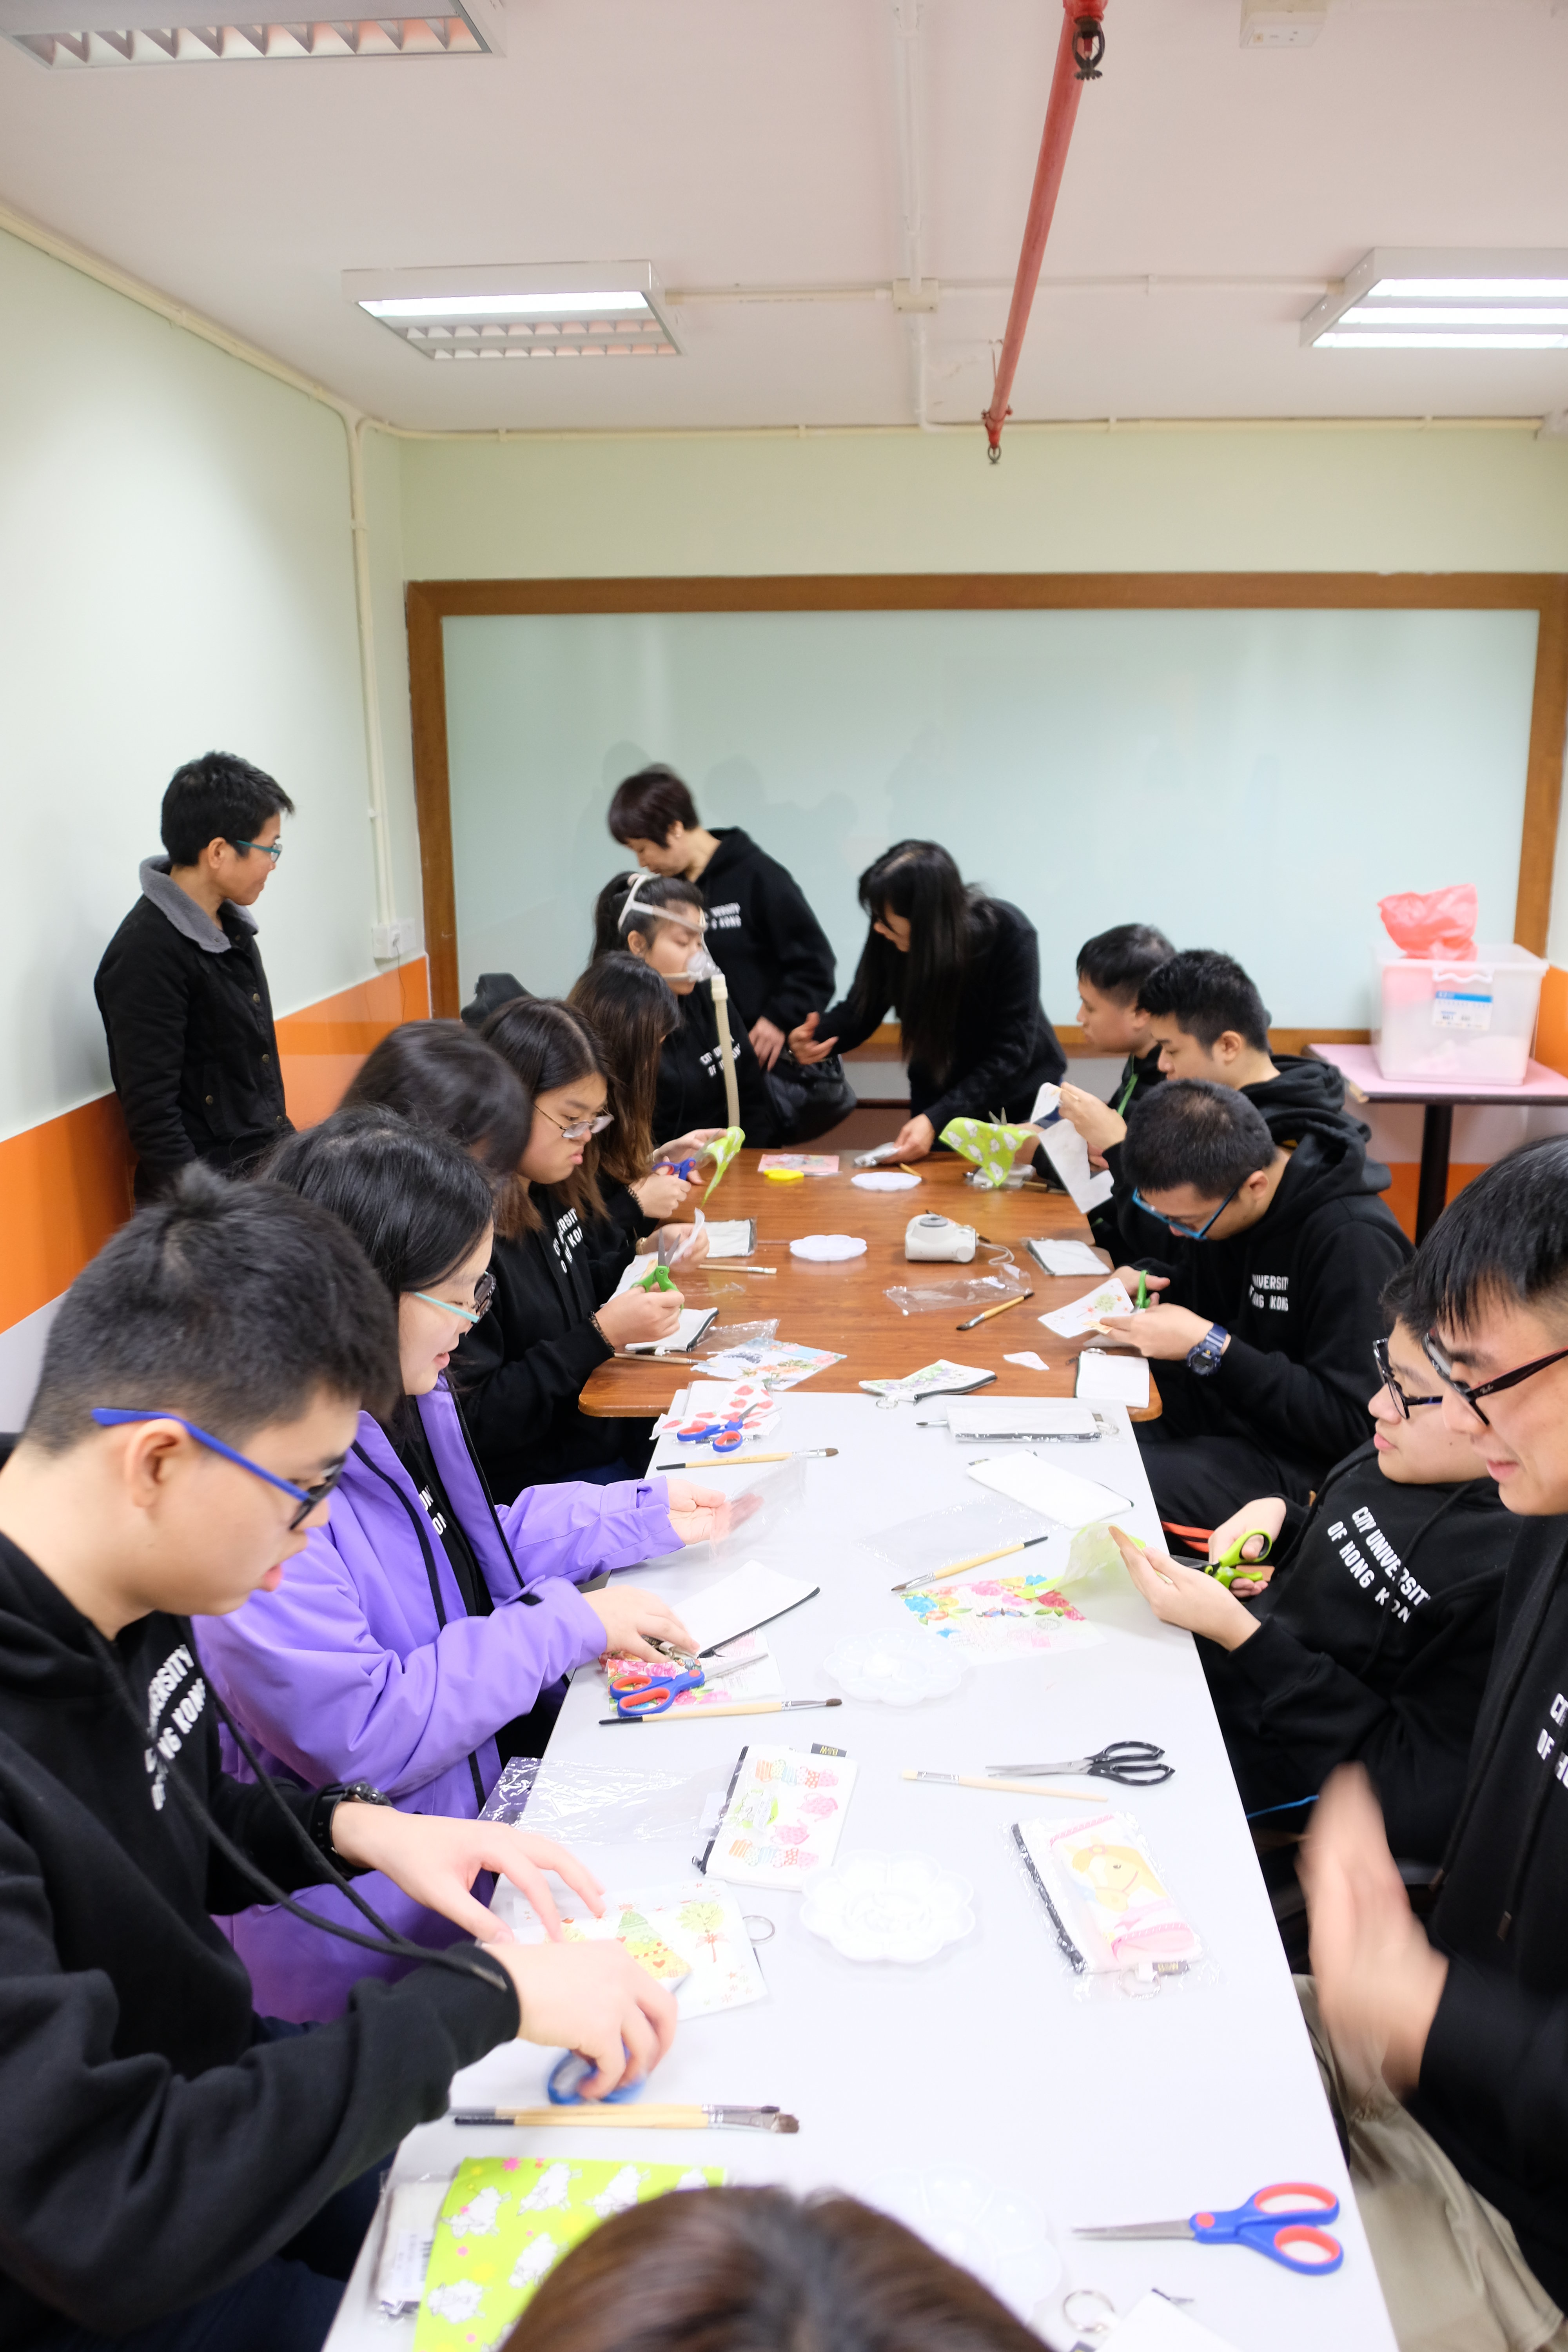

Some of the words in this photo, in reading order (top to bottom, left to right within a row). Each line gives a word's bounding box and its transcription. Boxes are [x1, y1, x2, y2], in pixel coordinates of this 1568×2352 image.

[1270, 1295, 1289, 1312] KONG
[1328, 1521, 1348, 1542] OF
[1339, 1540, 1375, 1588] HONG
[1352, 1506, 1377, 1533] CITY
[1366, 1529, 1431, 1606] UNIVERSIT
[1537, 1728, 1555, 1761] OF
